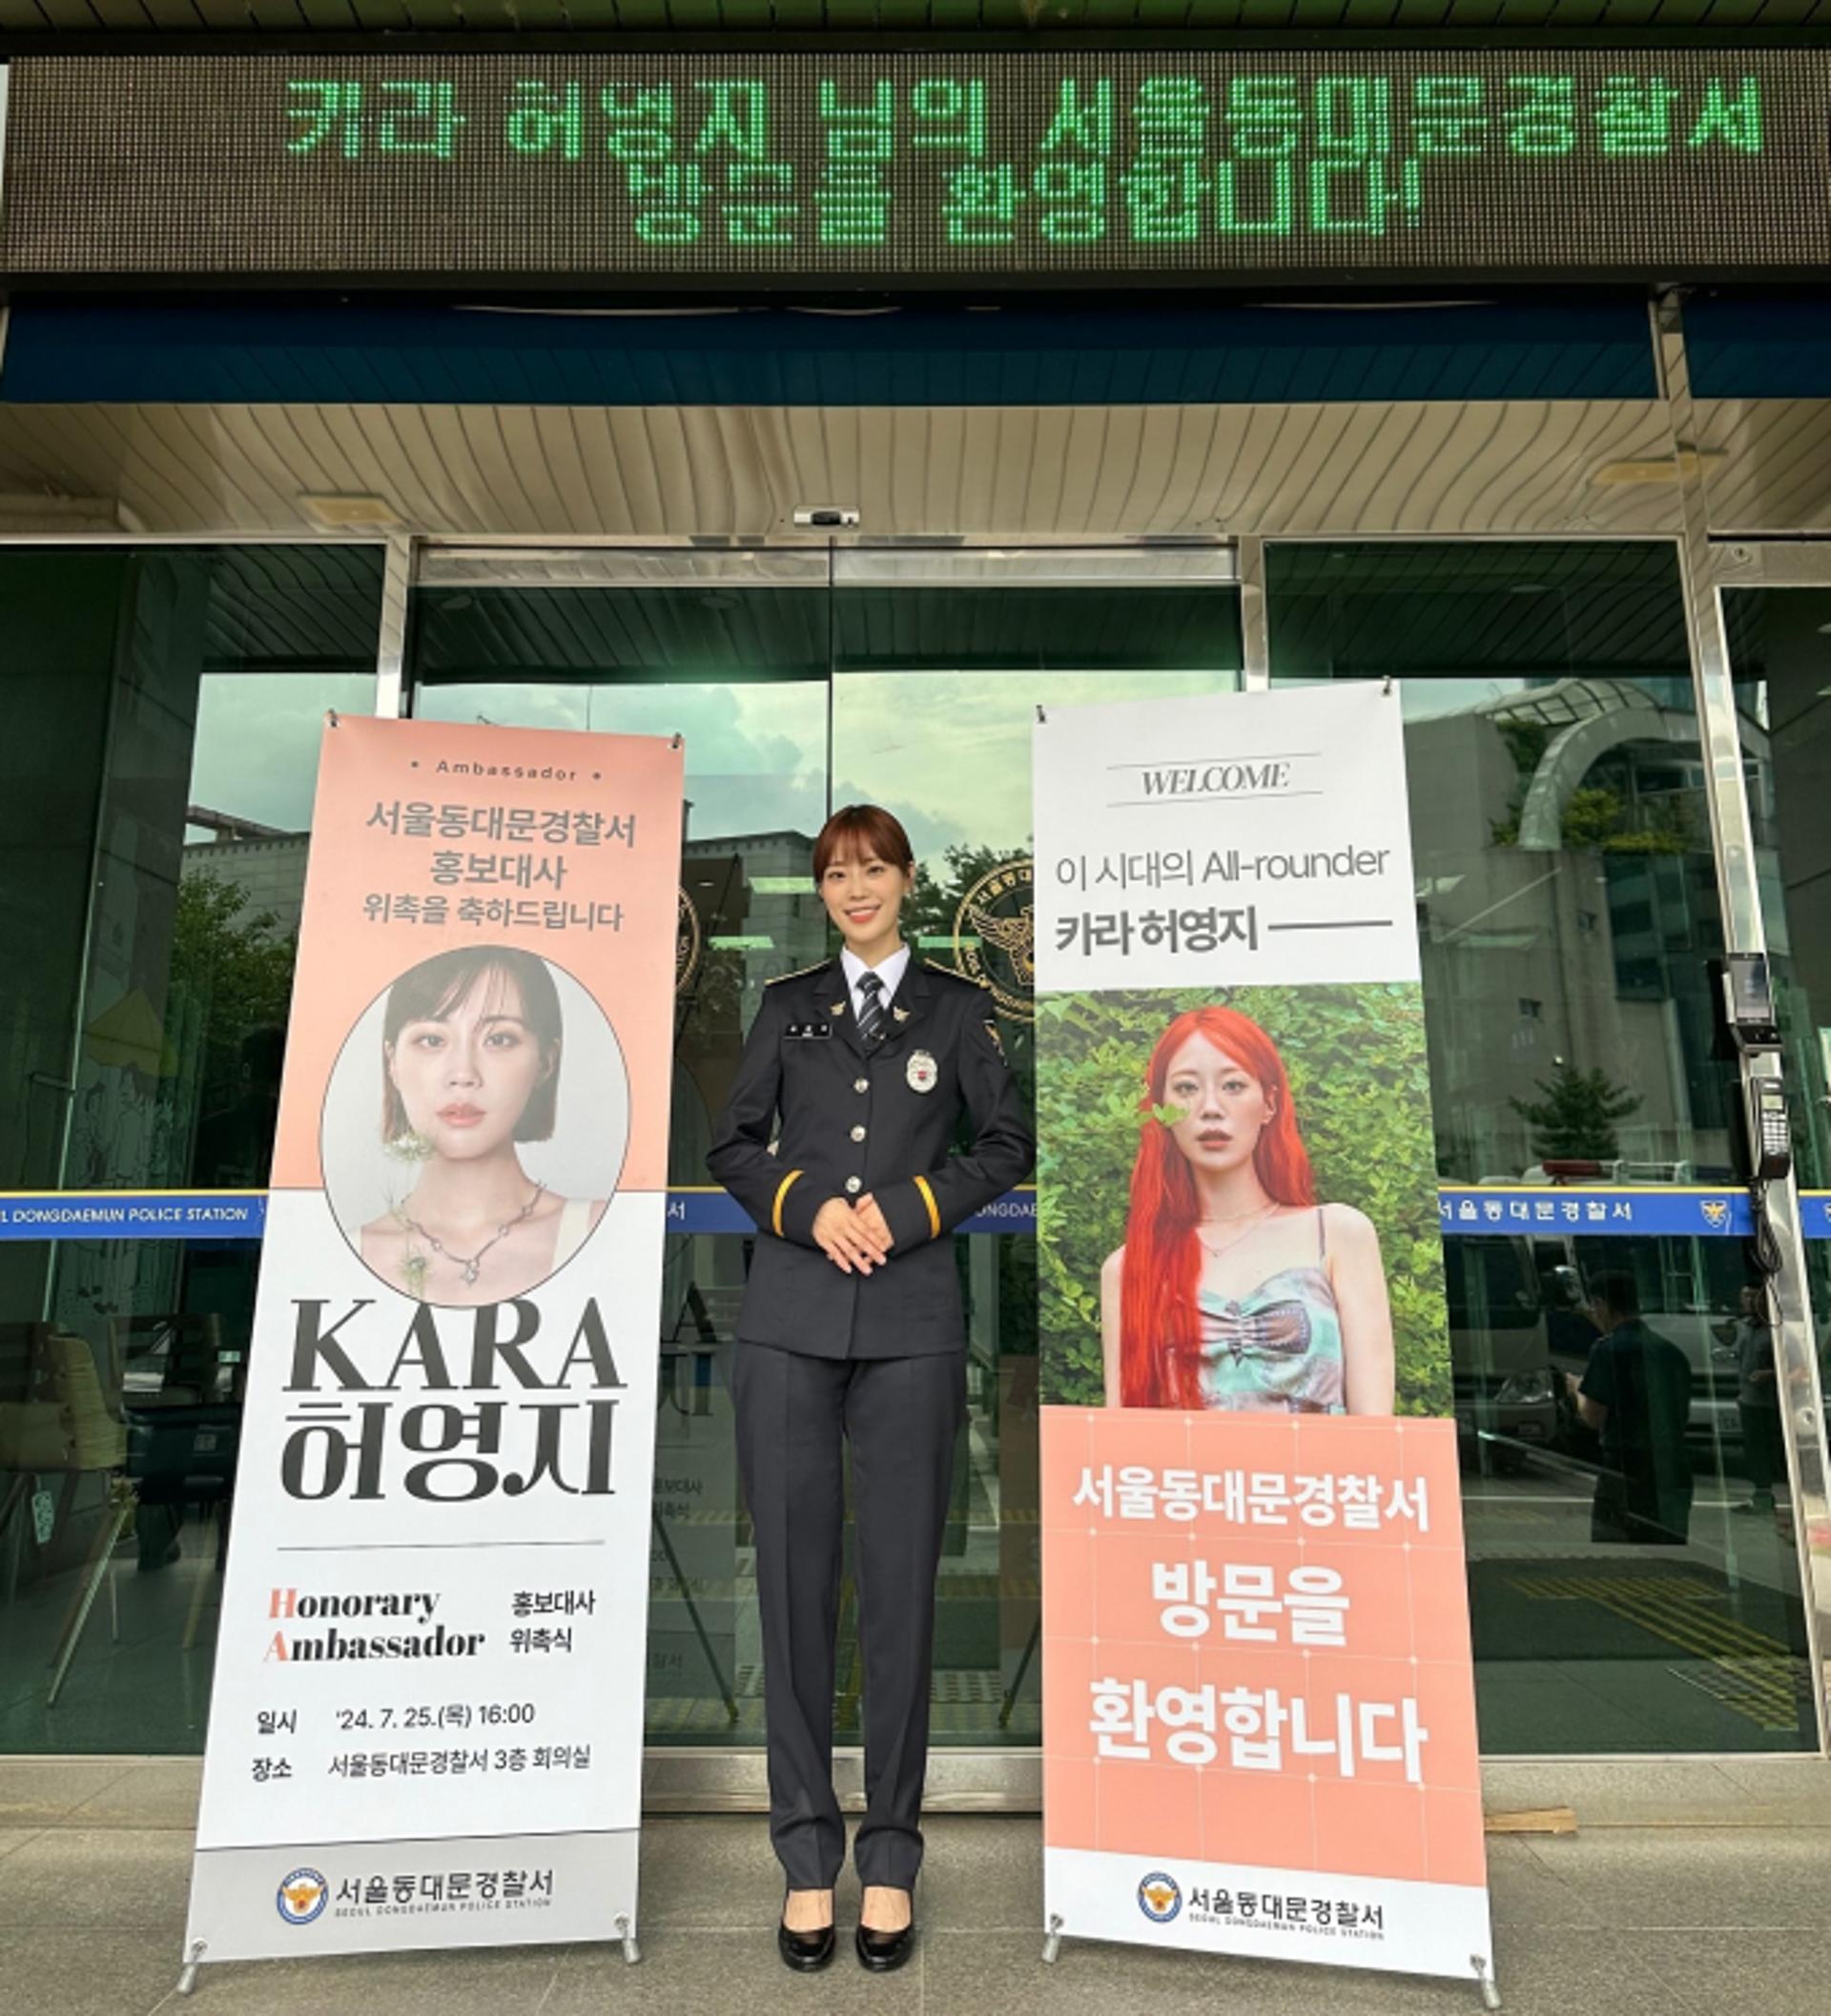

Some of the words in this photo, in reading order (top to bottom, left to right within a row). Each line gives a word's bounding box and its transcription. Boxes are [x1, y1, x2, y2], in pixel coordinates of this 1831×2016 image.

[287, 80, 466, 158] 카라
[819, 79, 986, 160] 님의
[626, 161, 893, 245] 방문을
[436, 759, 578, 782] Ambassador
[1142, 762, 1290, 795] WELCOME
[365, 800, 636, 848] 서울동대문경찰서
[430, 850, 567, 890] 홍보대사
[1057, 854, 1086, 892] 이
[1096, 849, 1193, 889] 시대의
[1202, 844, 1390, 884] All-rounder
[363, 893, 449, 925] 위촉을
[458, 897, 625, 932] 축하드립니다
[1056, 910, 1135, 957] 카라
[1140, 905, 1259, 954] 허영지
[12, 1207, 125, 1224] DONGDAEMUN
[129, 1207, 183, 1222] POLICE
[187, 1207, 250, 1222] STATION
[282, 1297, 627, 1391] KARA
[280, 1399, 620, 1502] 허영지
[1072, 1465, 1430, 1532] 서울동대문경찰서
[268, 1588, 442, 1624] Honorary
[511, 1590, 596, 1617] 홍보대사
[1151, 1559, 1350, 1647] 방문을
[263, 1624, 484, 1662] Ambassador
[509, 1627, 573, 1655] 위촉식
[257, 1709, 298, 1735] 일시
[380, 1708, 399, 1729] 7.
[480, 1703, 535, 1725] 16:00
[1089, 1677, 1430, 1784] 환영합니다
[252, 1758, 292, 1782] 장소
[328, 1748, 489, 1779] 서울동대문경찰서
[494, 1747, 527, 1772] 3층
[531, 1744, 592, 1771] 회의실
[336, 1869, 554, 1905] 서울동대문경찰서
[1188, 1887, 1384, 1930] 서울동대문경찰서
